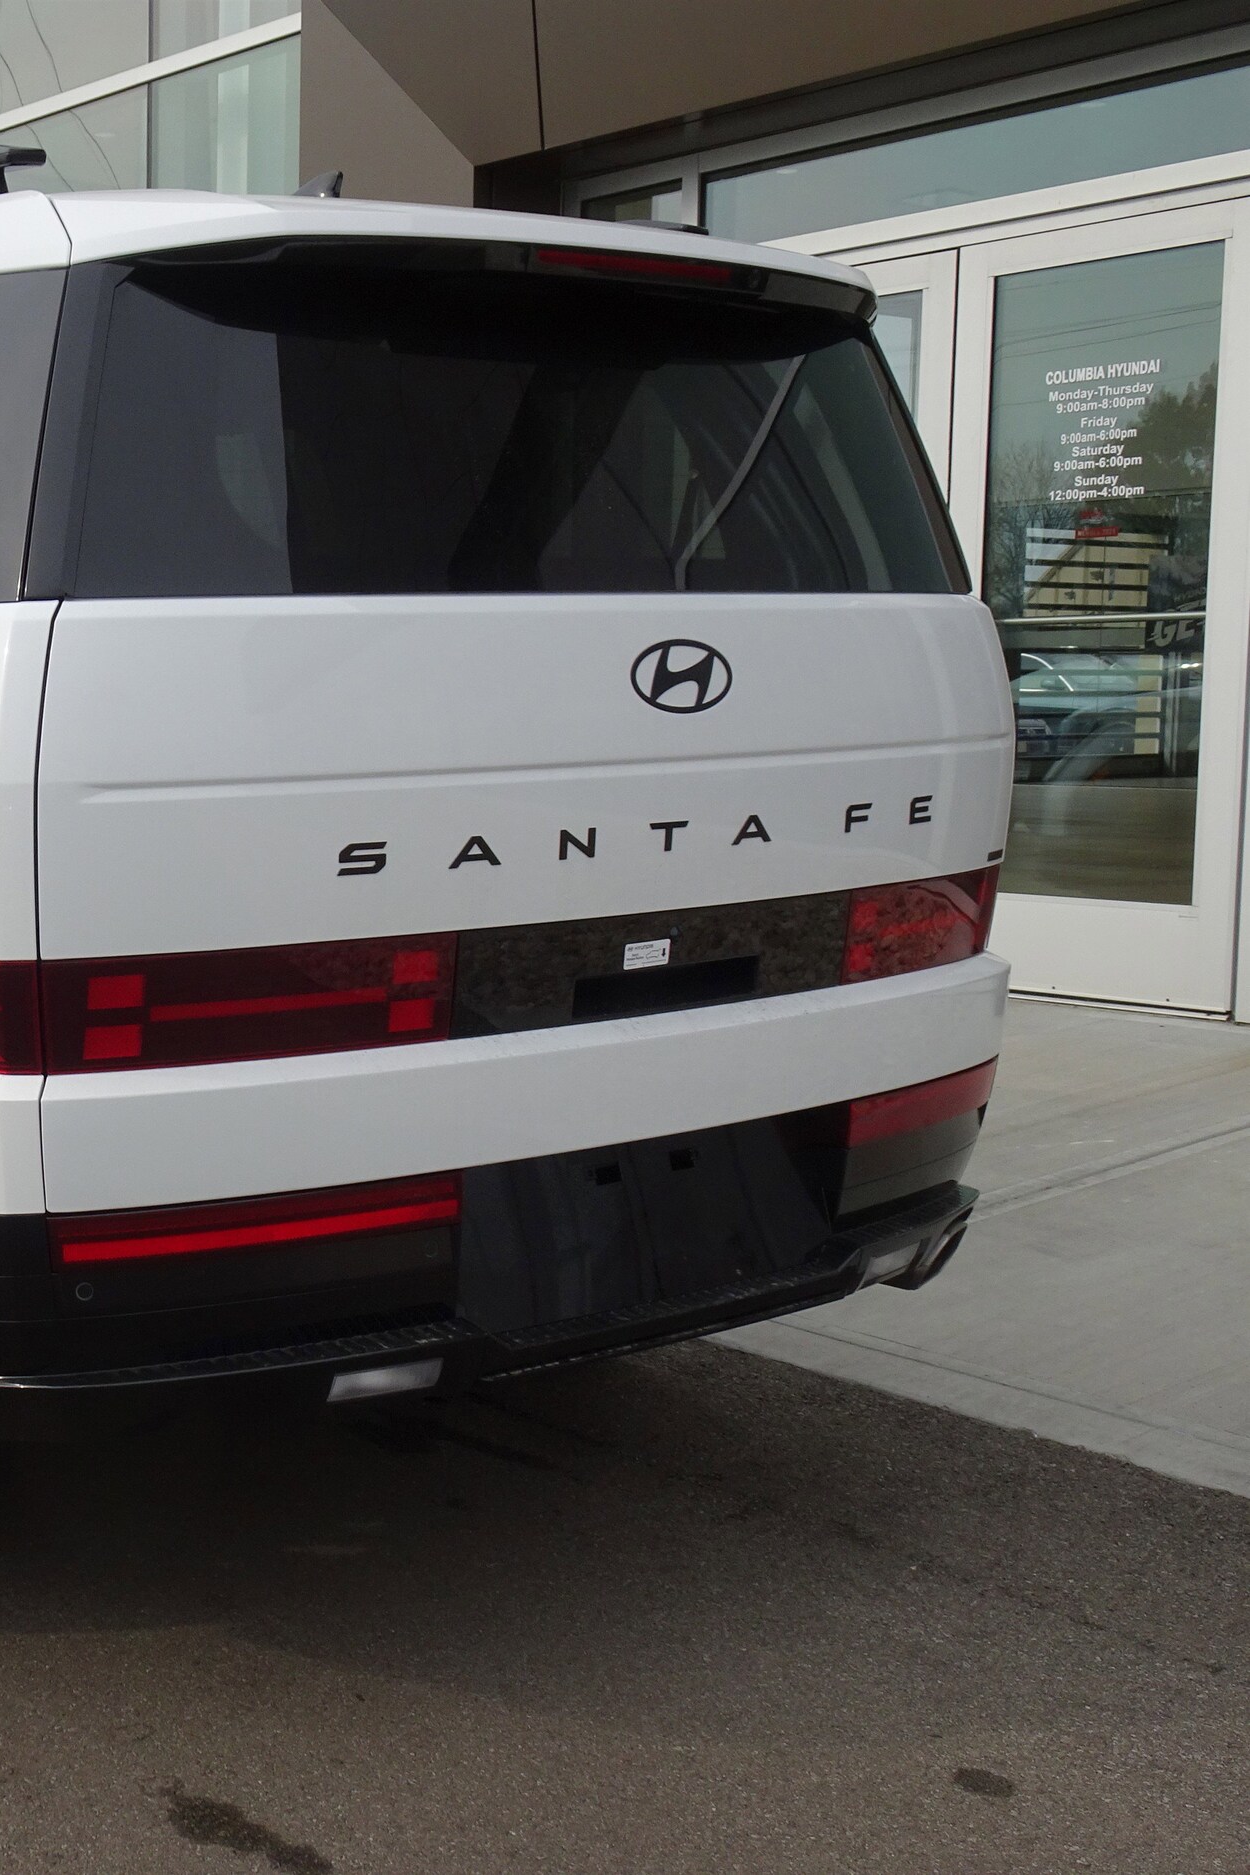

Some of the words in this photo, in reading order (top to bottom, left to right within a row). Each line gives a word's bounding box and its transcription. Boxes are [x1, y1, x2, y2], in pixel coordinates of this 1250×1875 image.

[1046, 365, 1105, 385] COLUMBIA
[1107, 359, 1160, 378] HYUNDAI
[1048, 382, 1154, 402] Monday-Thursday
[1056, 396, 1145, 414] 9:00am-8:00pm
[1080, 416, 1117, 428] Friday
[1060, 428, 1137, 445] 9:00am-6:00pm
[1072, 444, 1124, 457] Saturday
[1053, 456, 1142, 472] 9:00am-6:00pm
[1074, 474, 1119, 487] Sunday
[1049, 485, 1145, 501] 12:00pm-4:00pm
[336, 814, 772, 877] SANTA
[844, 795, 934, 834] FE
